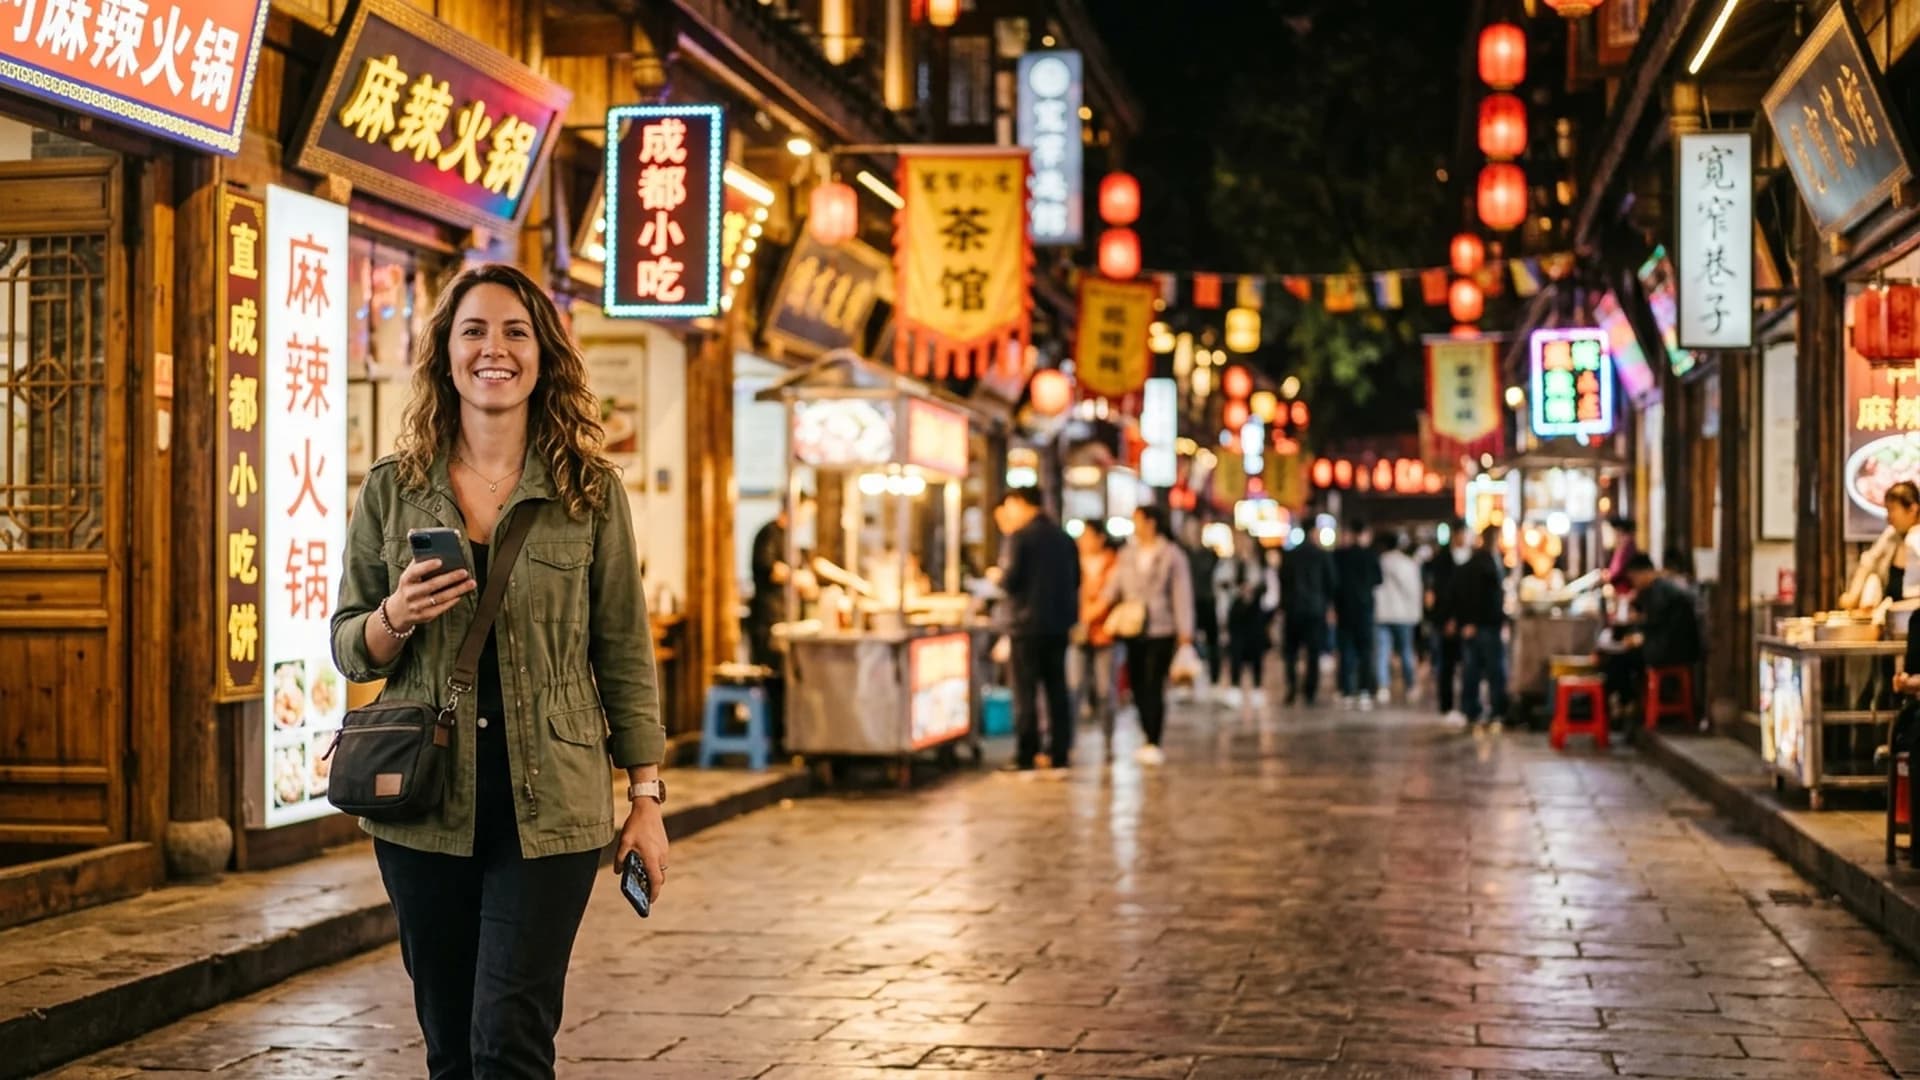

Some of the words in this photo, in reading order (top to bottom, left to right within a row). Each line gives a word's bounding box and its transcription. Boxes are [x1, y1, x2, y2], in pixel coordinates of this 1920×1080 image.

[340, 55, 537, 200] 麻辣火锅
[637, 118, 687, 302] 成都小吃
[939, 206, 990, 311] 茶馆
[228, 222, 258, 661] 直成都小吃饼
[286, 234, 331, 620] 麻辣火锅
